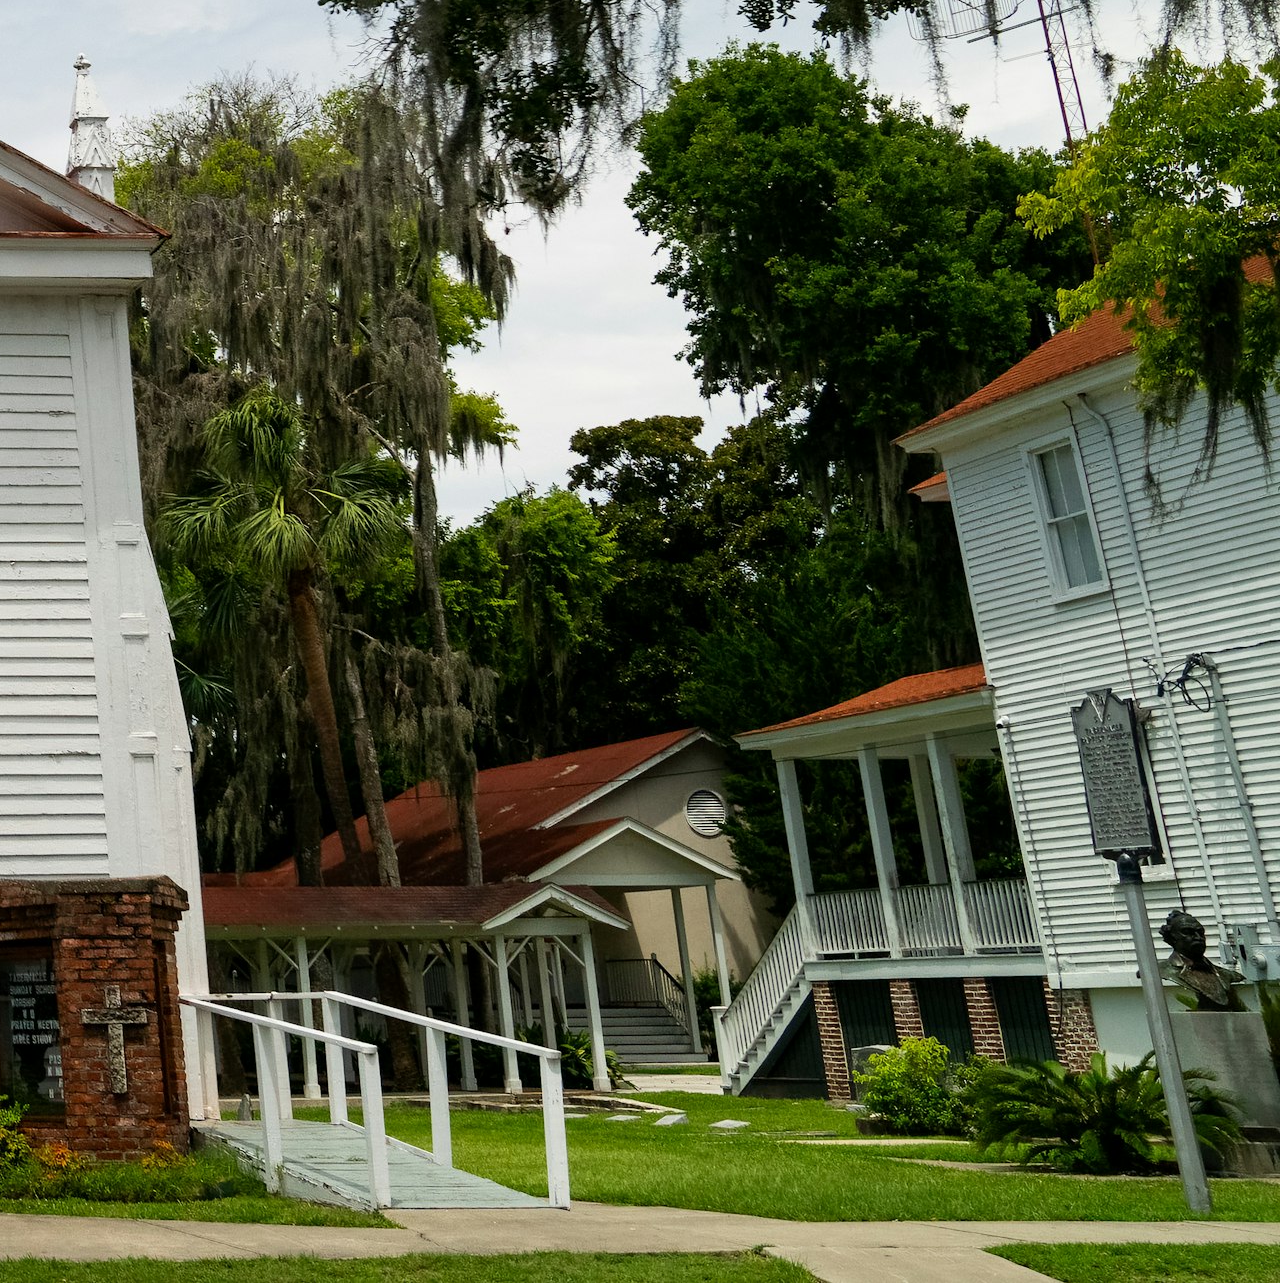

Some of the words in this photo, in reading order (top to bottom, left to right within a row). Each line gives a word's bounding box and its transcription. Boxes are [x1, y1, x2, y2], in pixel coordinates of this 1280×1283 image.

[9, 971, 47, 983] TABERNACLE
[9, 984, 33, 995] SUNDAY
[10, 997, 36, 1008] WORSHIP
[11, 1020, 35, 1030] PRAYER
[12, 1033, 31, 1045] BIBLE
[32, 1033, 53, 1045] STUDY
